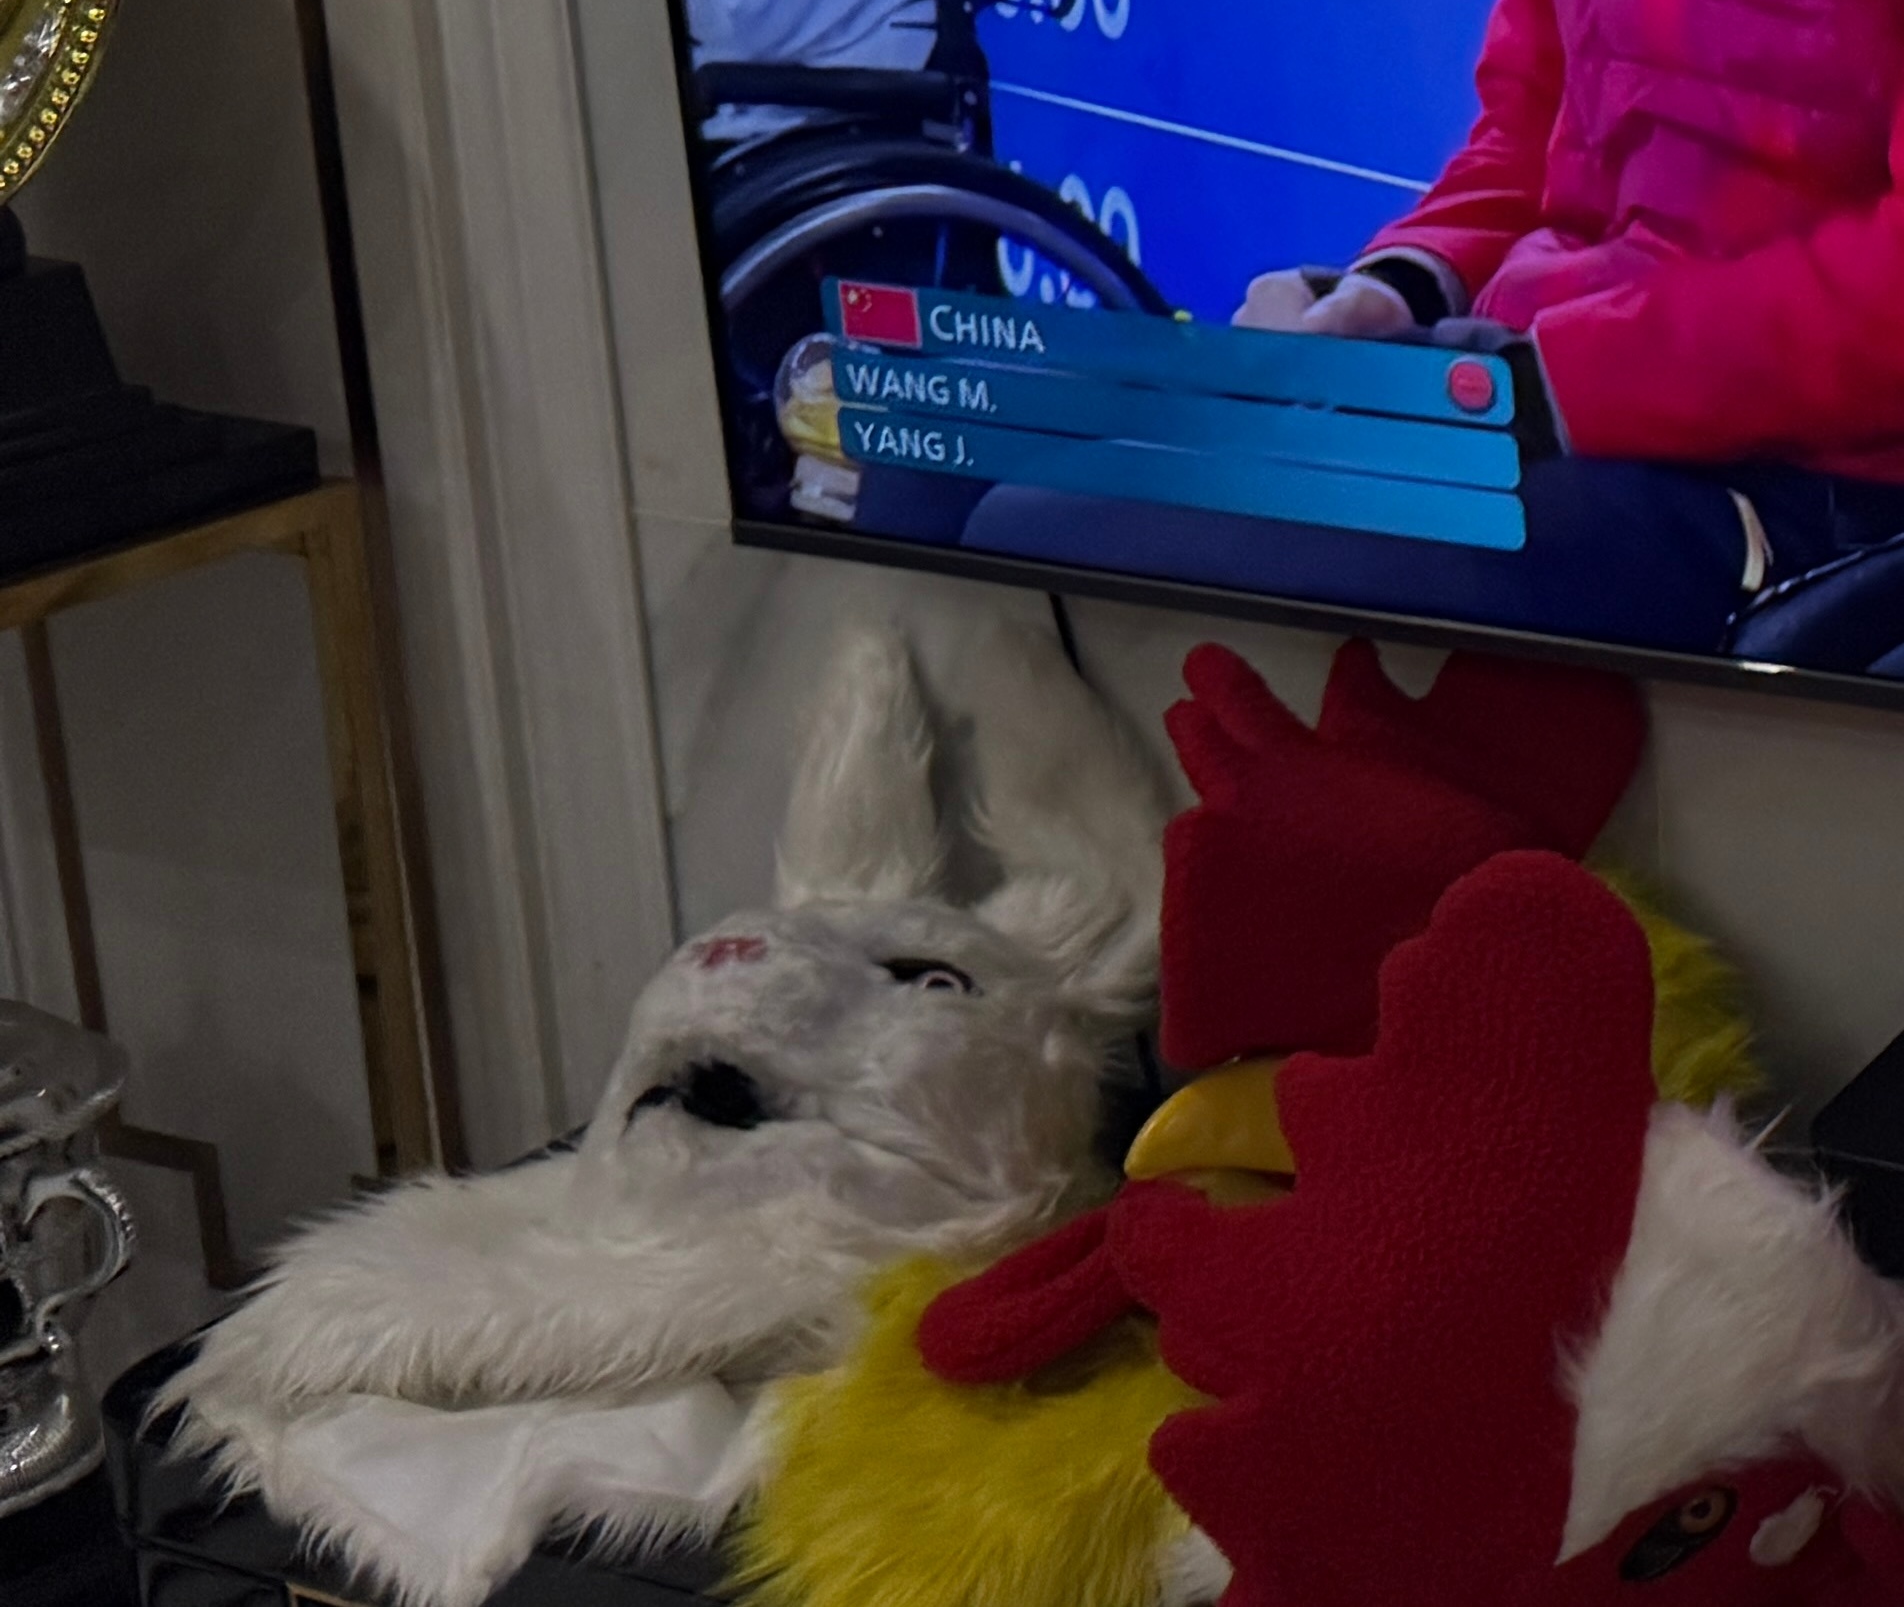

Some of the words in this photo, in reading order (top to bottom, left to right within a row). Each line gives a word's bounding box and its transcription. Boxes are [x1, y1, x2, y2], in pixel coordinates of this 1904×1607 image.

[930, 304, 1046, 354] CHINA
[846, 363, 951, 406] WANG
[957, 378, 998, 414] M.
[854, 420, 946, 463] YANG
[952, 435, 975, 467] J.
